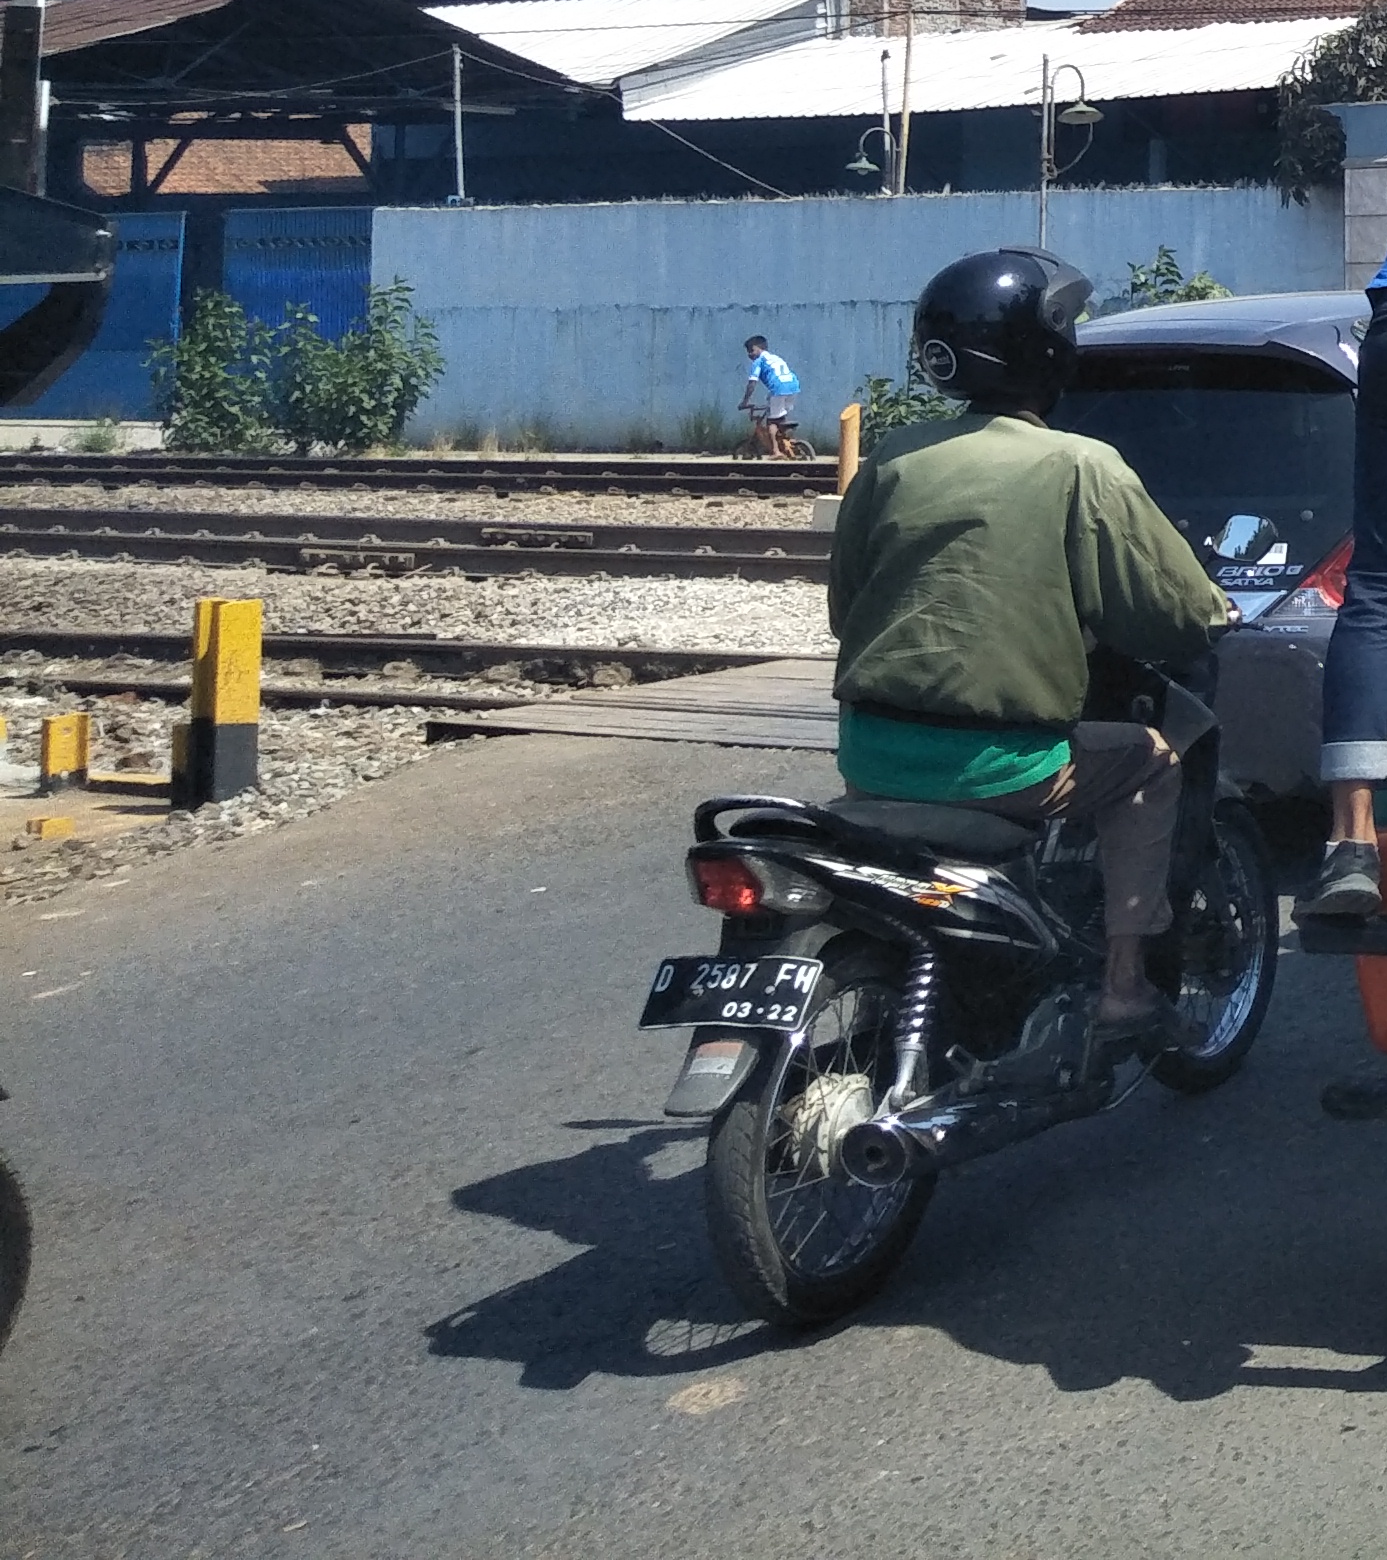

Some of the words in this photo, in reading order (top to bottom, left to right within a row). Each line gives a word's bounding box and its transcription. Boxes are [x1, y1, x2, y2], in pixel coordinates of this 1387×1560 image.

[1220, 578, 1274, 586] SATYA
[655, 965, 674, 993] D
[690, 962, 757, 991] 2587
[774, 963, 818, 994] FH
